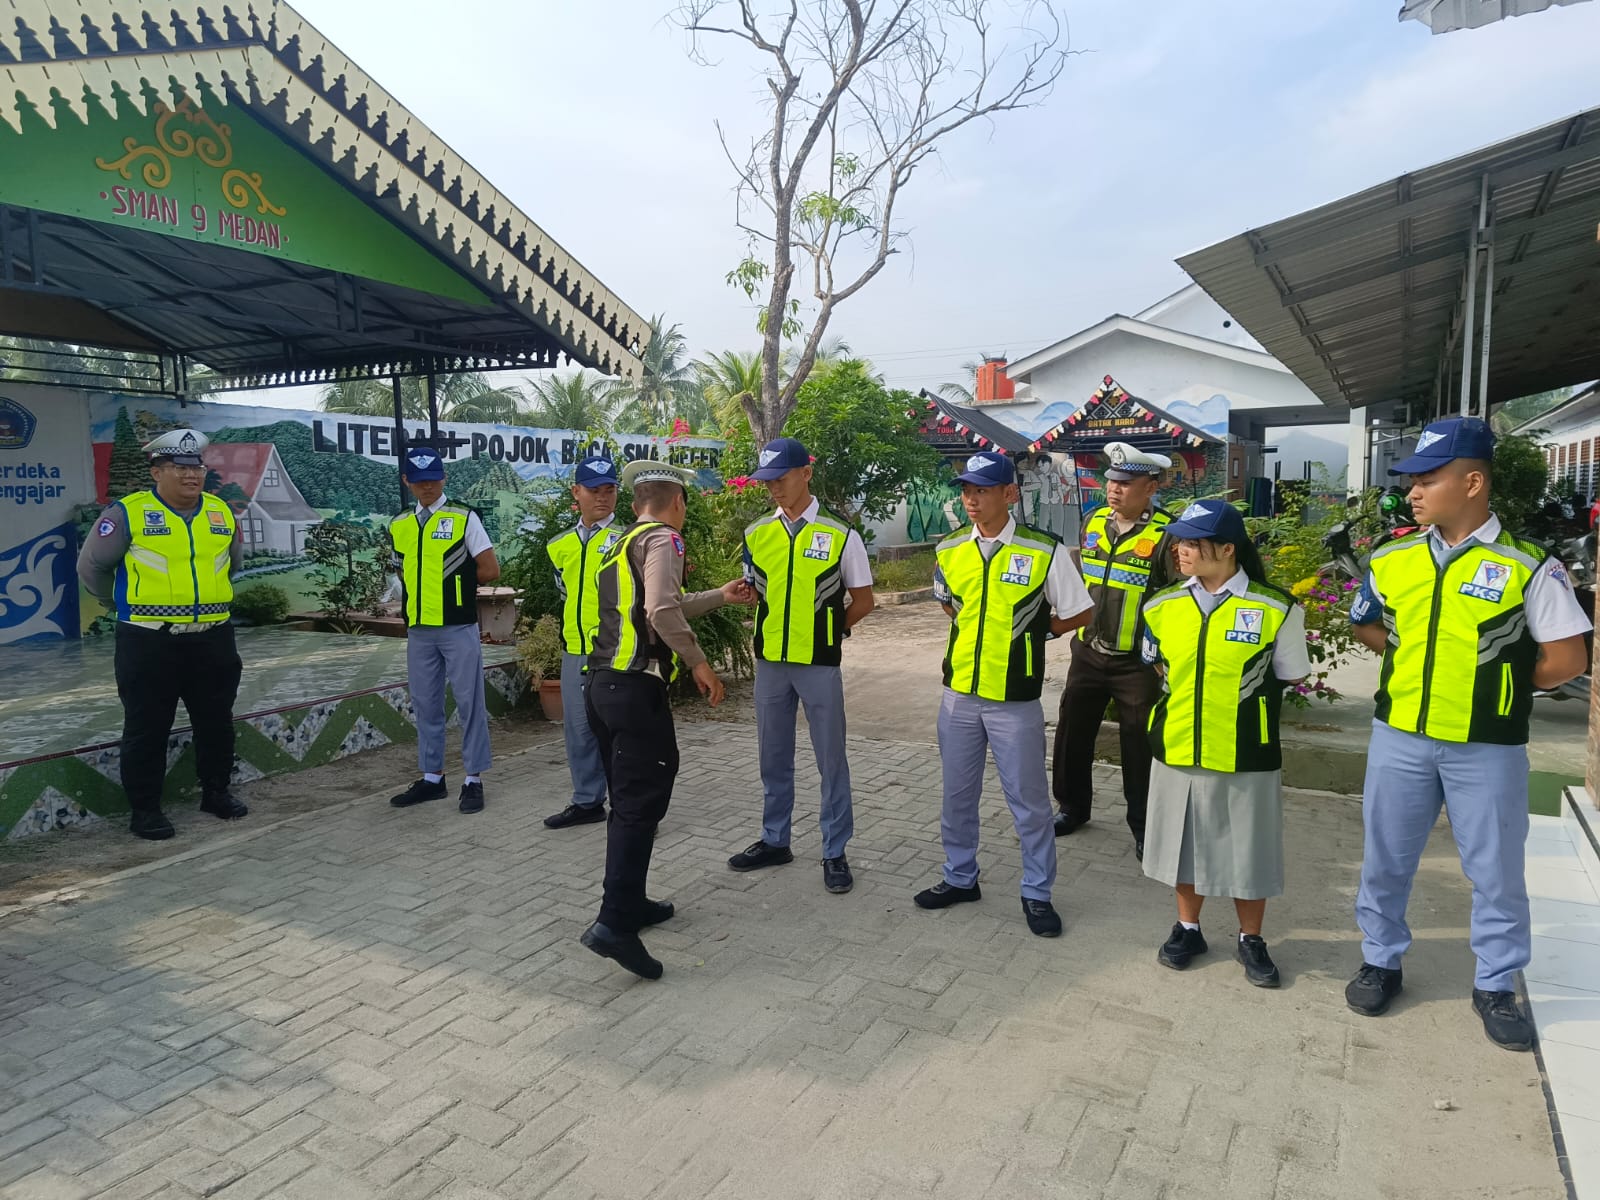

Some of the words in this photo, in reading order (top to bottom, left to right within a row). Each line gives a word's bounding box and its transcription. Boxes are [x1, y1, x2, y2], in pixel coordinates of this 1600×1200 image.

[112, 185, 179, 226] SMAN
[191, 204, 208, 232] 9
[218, 209, 281, 250] MEDAN
[471, 432, 550, 463] POJOK
[624, 443, 659, 463] SMA
[0, 463, 60, 478] rdeka
[804, 548, 829, 560] PKS
[1001, 572, 1029, 585] PKS
[1459, 584, 1501, 602] PKS
[1226, 631, 1260, 643] PKS
